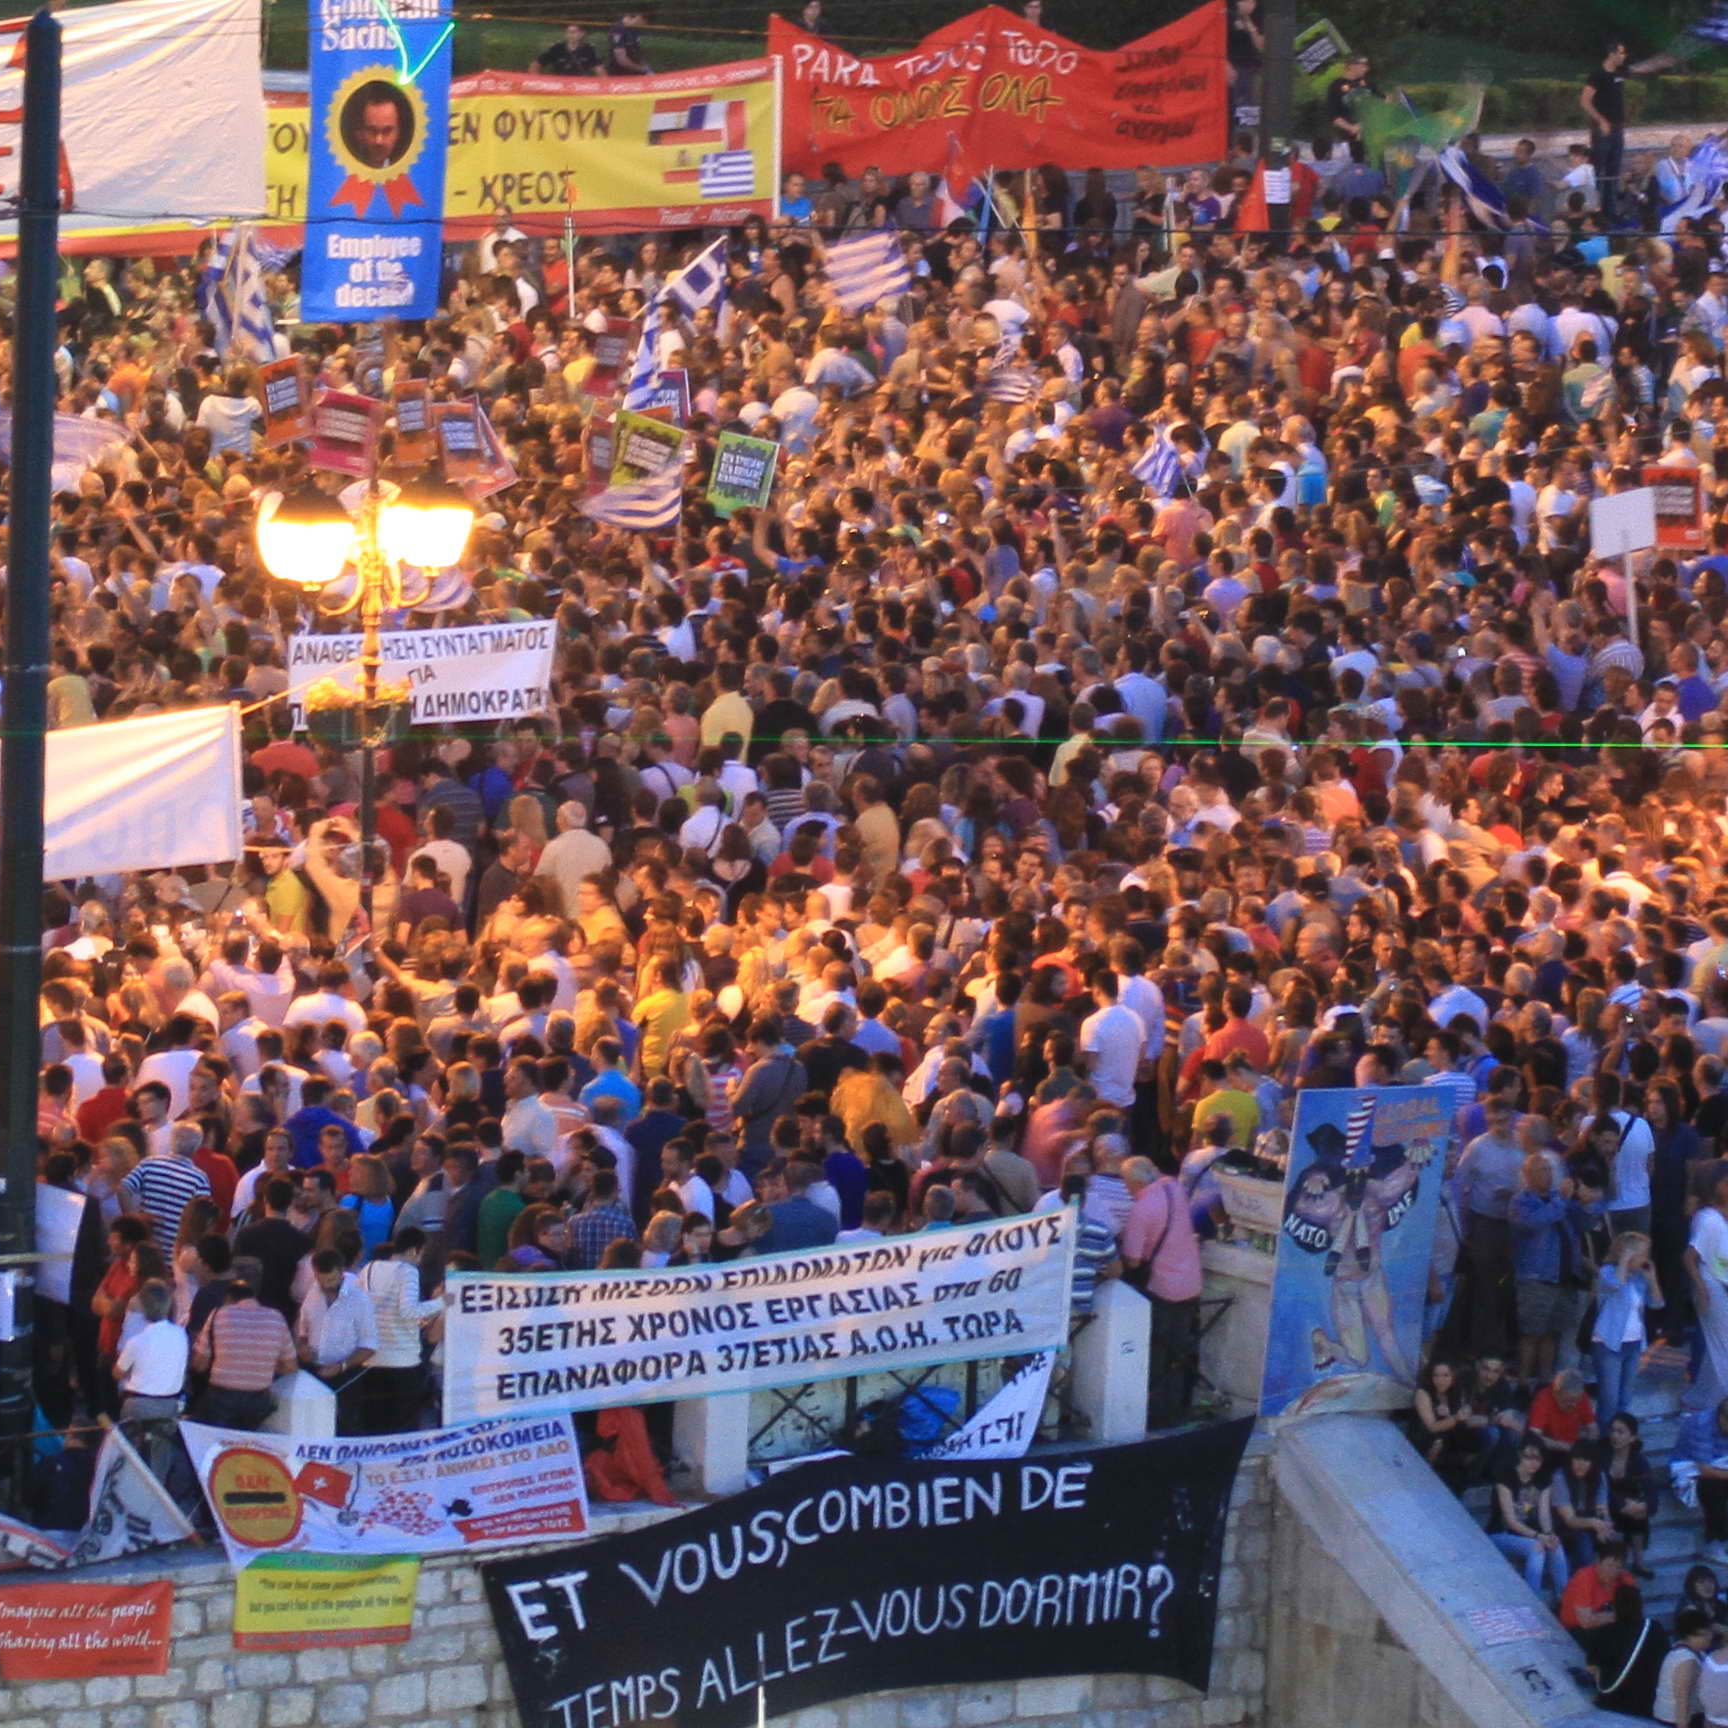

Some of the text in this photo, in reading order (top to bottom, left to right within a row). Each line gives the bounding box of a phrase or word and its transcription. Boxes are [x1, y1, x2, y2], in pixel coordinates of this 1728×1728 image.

[320, 20, 402, 51] Sachs
[791, 43, 880, 87] PARA
[978, 73, 1064, 123] ΟΛΑ
[493, 108, 614, 142] ΦΥΓΟΥΝ
[327, 234, 422, 260] Employee
[349, 258, 408, 283] of the
[292, 625, 549, 666] ΑΝΑΘΕΗΣΗ ΣΥΝΤΑΓΜΑΤΟΣ
[422, 686, 549, 718] ΔΗΜΟΚΡΑΤΙ
[1387, 1190, 1414, 1226] IMF
[917, 1240, 959, 1273] για
[962, 1214, 1066, 1259] ΟΛΟΥΣ
[1283, 1212, 1329, 1248] NATO
[497, 1316, 619, 1358] 35ΕΤΗΣ
[627, 1300, 760, 1346] ΧΡΟΝΟΣ
[764, 1282, 922, 1329] ΕΡΓΑΣΙΑΣ
[985, 1268, 1023, 1296] 60
[494, 1347, 707, 1404] ΕΠΑΝΑΦΟΡΑ
[715, 1330, 841, 1376] 37ΕΤΙΑΣ
[942, 1307, 1026, 1346] ΤΩΡΑ
[433, 1419, 566, 1462] ΝΟΣΟΚΟΜΕΙΑ
[436, 1455, 497, 1478] ΑΝΗΚΕΙ
[500, 1447, 531, 1466] ΣΤΟ
[503, 1570, 590, 1648] ET
[1018, 1463, 1096, 1512] DE
[58, 1603, 83, 1619] all
[86, 1603, 110, 1619] the
[110, 1599, 158, 1628] people
[57, 1630, 81, 1650] all
[84, 1630, 110, 1649] the
[550, 1561, 1176, 1728] TEMPS ALLEZ-VOUS DORMIR?
